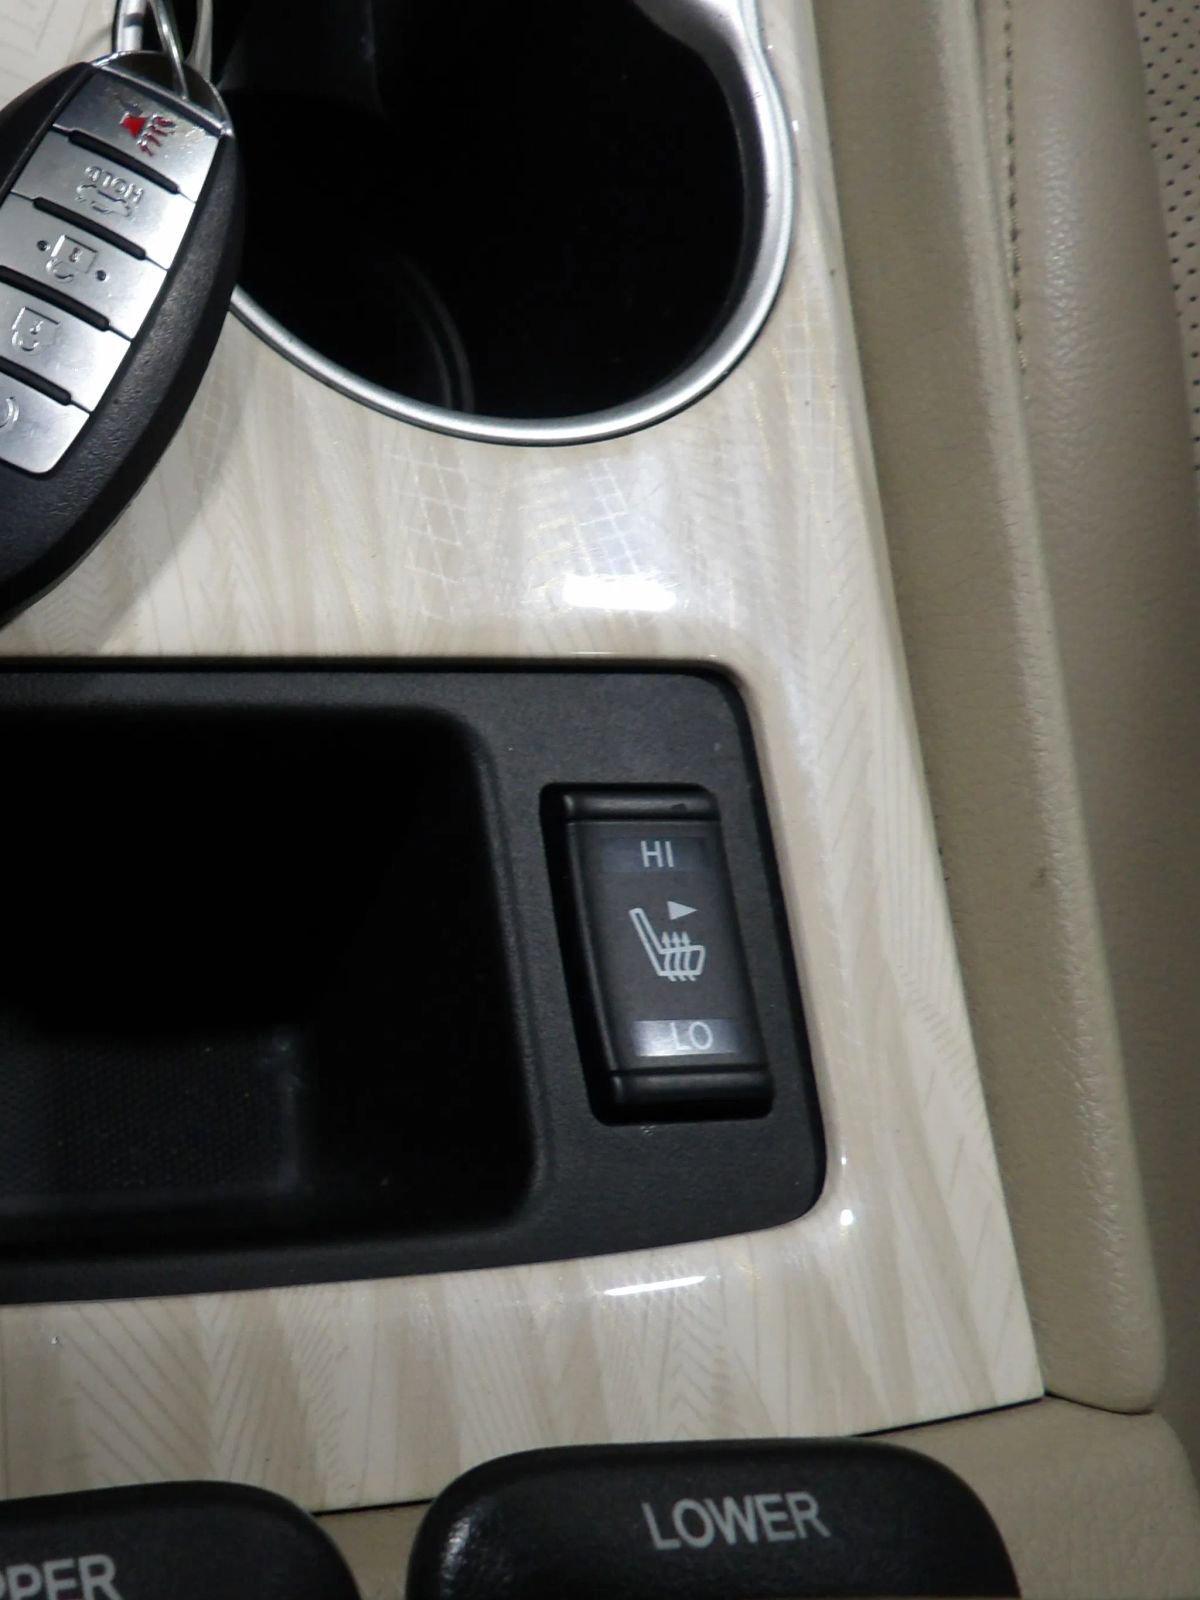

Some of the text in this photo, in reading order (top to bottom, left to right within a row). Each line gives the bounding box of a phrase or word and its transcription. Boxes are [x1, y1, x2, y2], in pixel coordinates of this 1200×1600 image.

[85, 165, 144, 200] HOLD
[640, 840, 674, 867] HI
[669, 1021, 713, 1051] LO
[641, 1491, 831, 1550] LOWER
